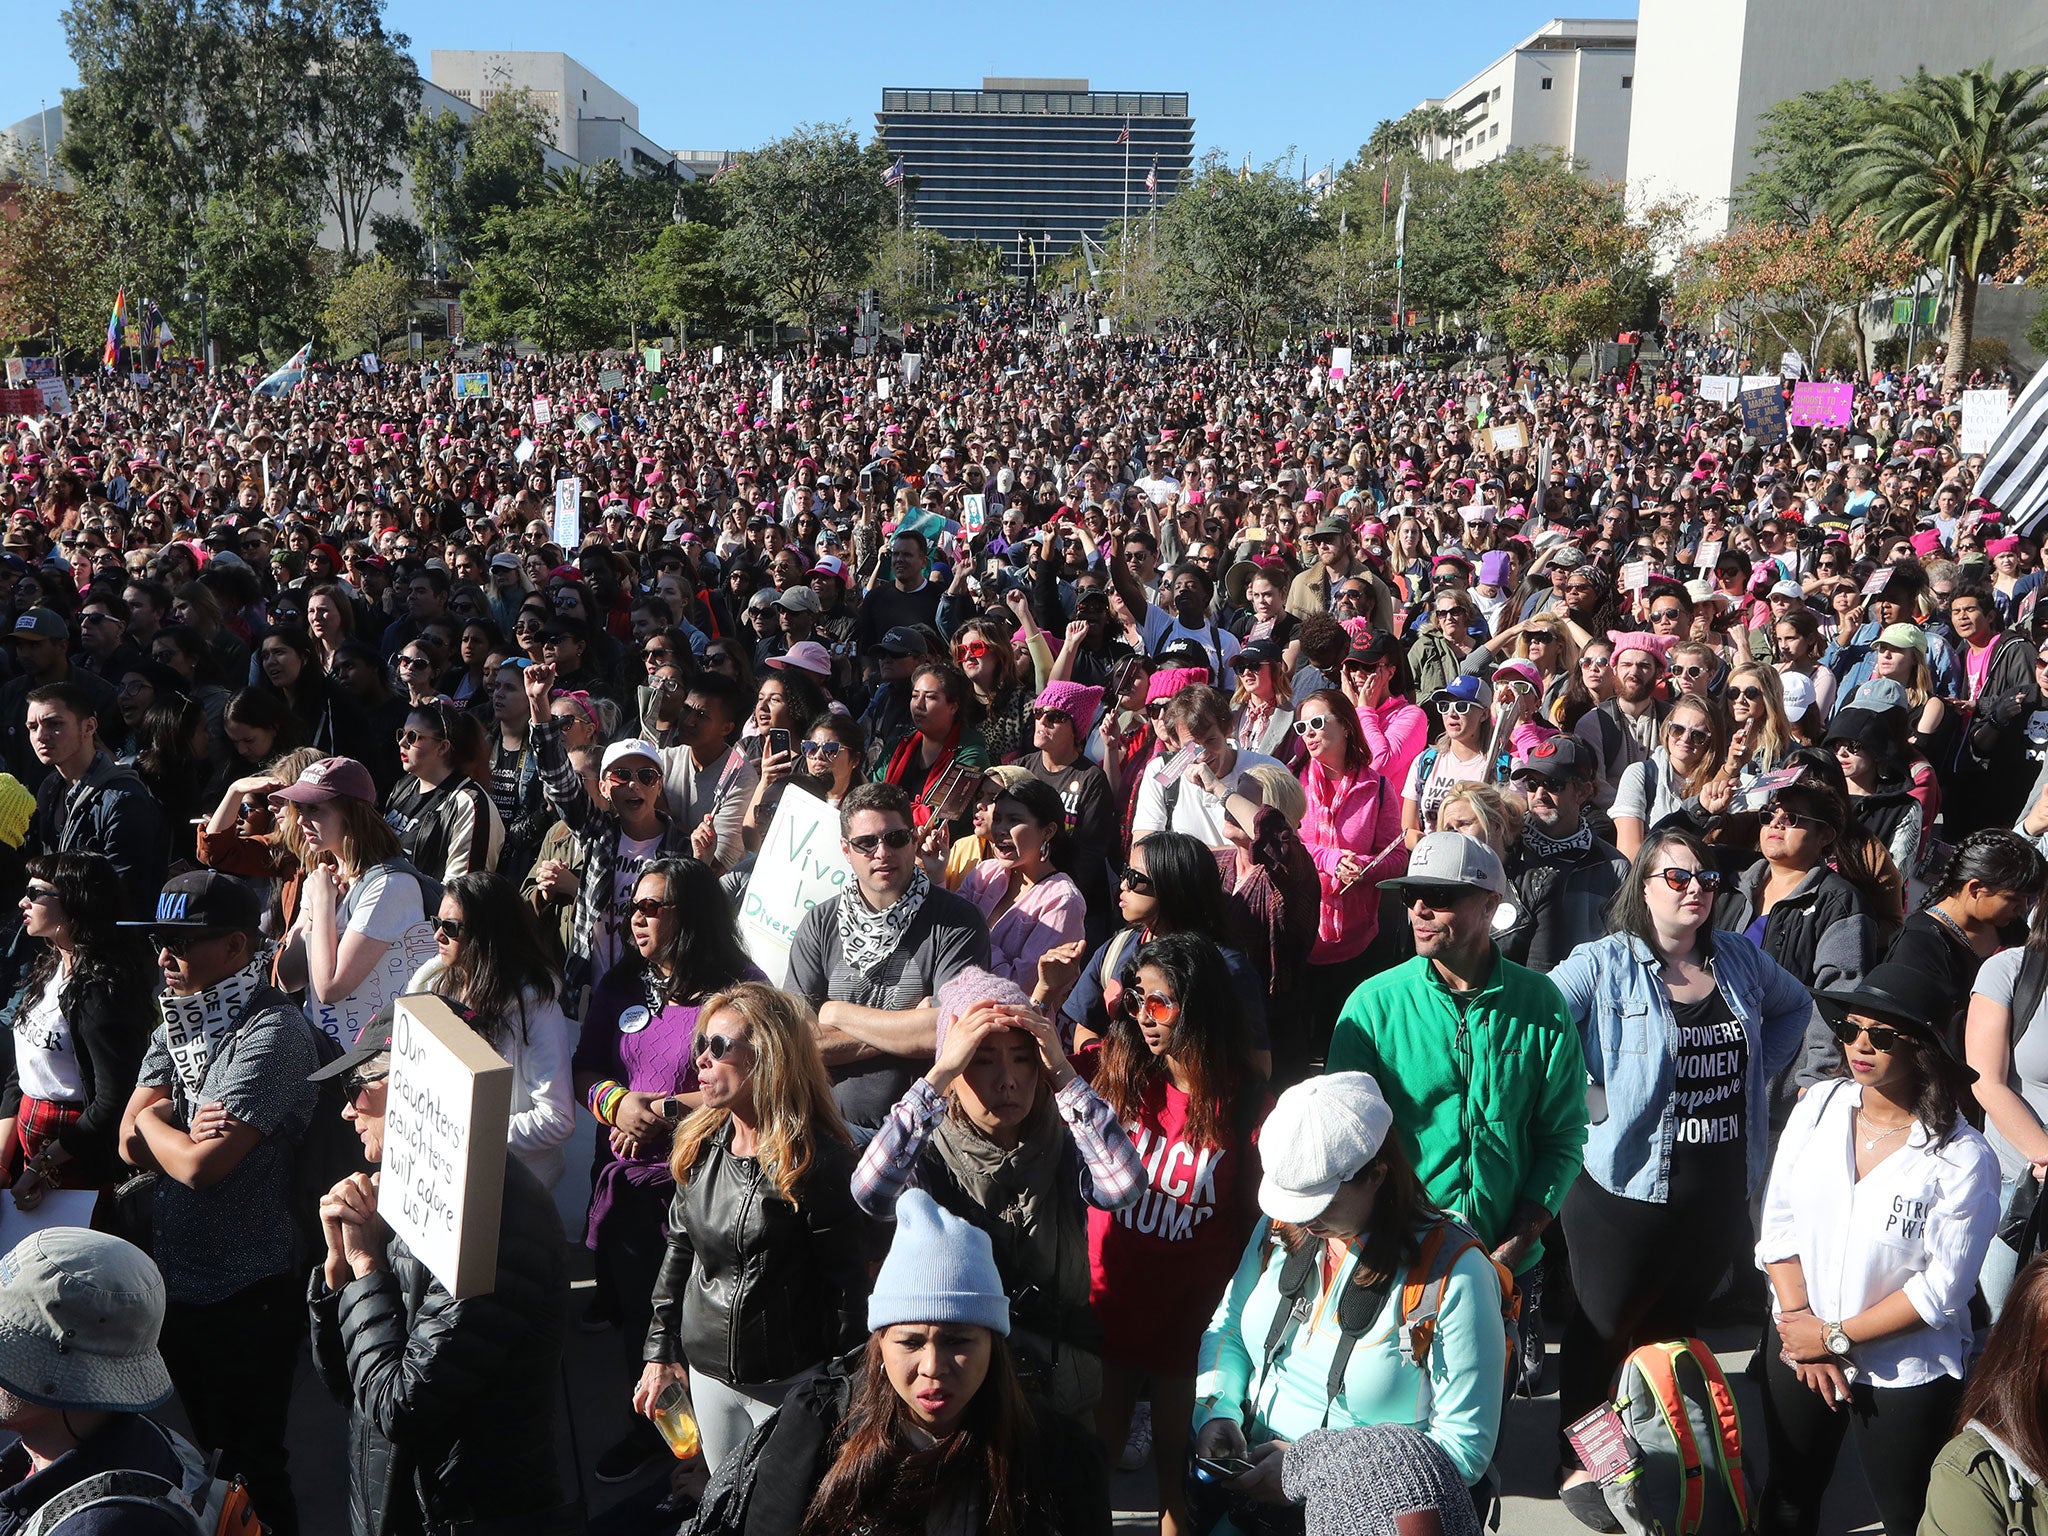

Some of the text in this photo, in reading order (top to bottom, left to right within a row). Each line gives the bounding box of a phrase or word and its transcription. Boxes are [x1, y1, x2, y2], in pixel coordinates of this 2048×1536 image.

[1743, 386, 1777, 401] SEE JANE
[1747, 404, 1780, 419] SEE JANE
[1965, 392, 2007, 406] POWER
[1964, 415, 2000, 424] PEOPLE
[790, 815, 847, 885] Viva
[162, 998, 188, 1047] VOTE
[183, 1000, 206, 1047] VOTE
[398, 1013, 426, 1066] Our
[1675, 1049, 1740, 1079] WOMEN
[388, 1097, 453, 1185] daughters
[1673, 1113, 1739, 1144] WOMEN
[1129, 1121, 1226, 1204] UCK
[390, 1145, 454, 1232] will adore
